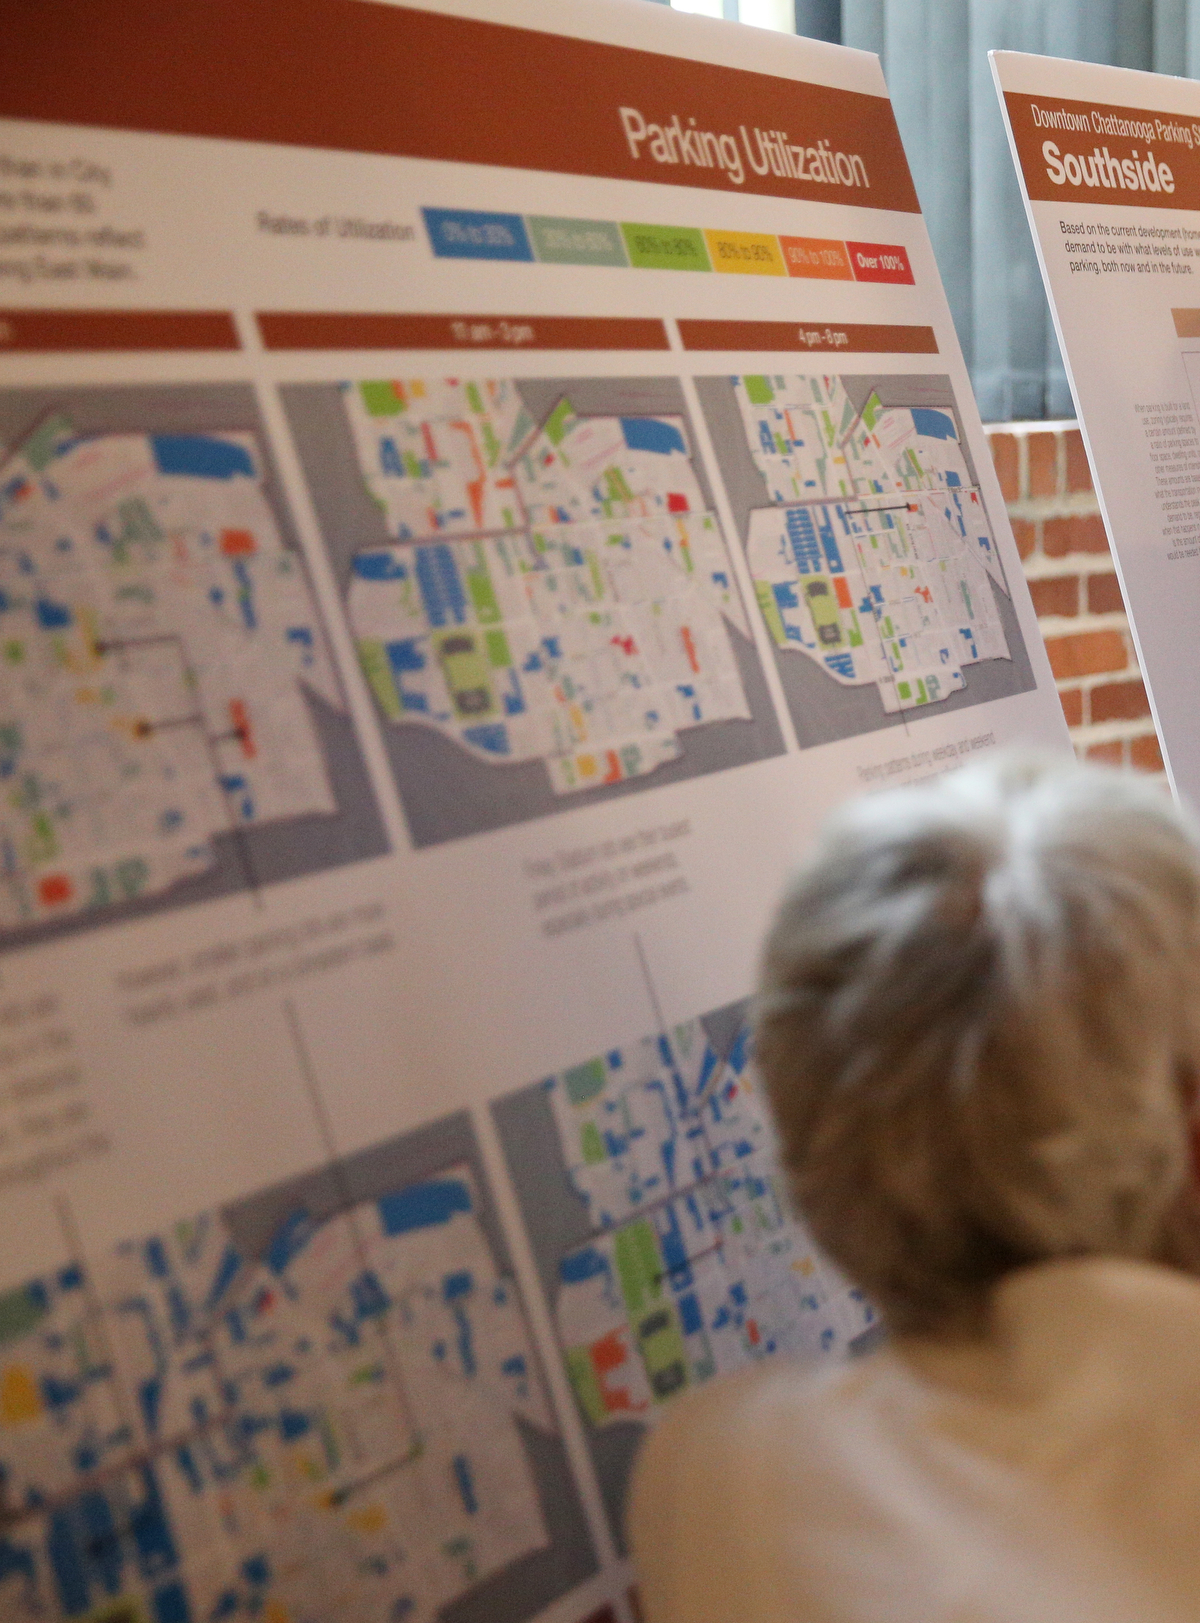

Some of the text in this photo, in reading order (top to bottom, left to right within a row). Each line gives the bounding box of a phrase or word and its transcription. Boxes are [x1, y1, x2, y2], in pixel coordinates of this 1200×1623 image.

[1030, 103, 1091, 133] Downtown
[1091, 111, 1157, 144] Chattanooga
[1154, 119, 1194, 149] Parking
[618, 106, 870, 188] Parking Utilization
[1042, 140, 1176, 194] Southside
[257, 209, 415, 241] Rates of Utilization
[1059, 220, 1085, 235] Based
[1086, 225, 1097, 235] on
[1097, 223, 1111, 236] the
[1111, 224, 1137, 237] current
[1138, 225, 1182, 240] development
[739, 242, 751, 261] to
[809, 247, 820, 265] to
[818, 248, 845, 267] 100%
[1065, 240, 1096, 253] demand
[1096, 242, 1106, 254] to
[1106, 241, 1117, 254] be
[1117, 242, 1134, 255] with
[1134, 243, 1152, 255] what
[1152, 244, 1172, 256] levels
[1172, 244, 1180, 256] of
[1181, 248, 1194, 257] use
[855, 251, 904, 272] Over 100%
[1069, 259, 1194, 275] parking, both now and in the future.
[807, 331, 821, 345] pm
[834, 331, 849, 346] pm
